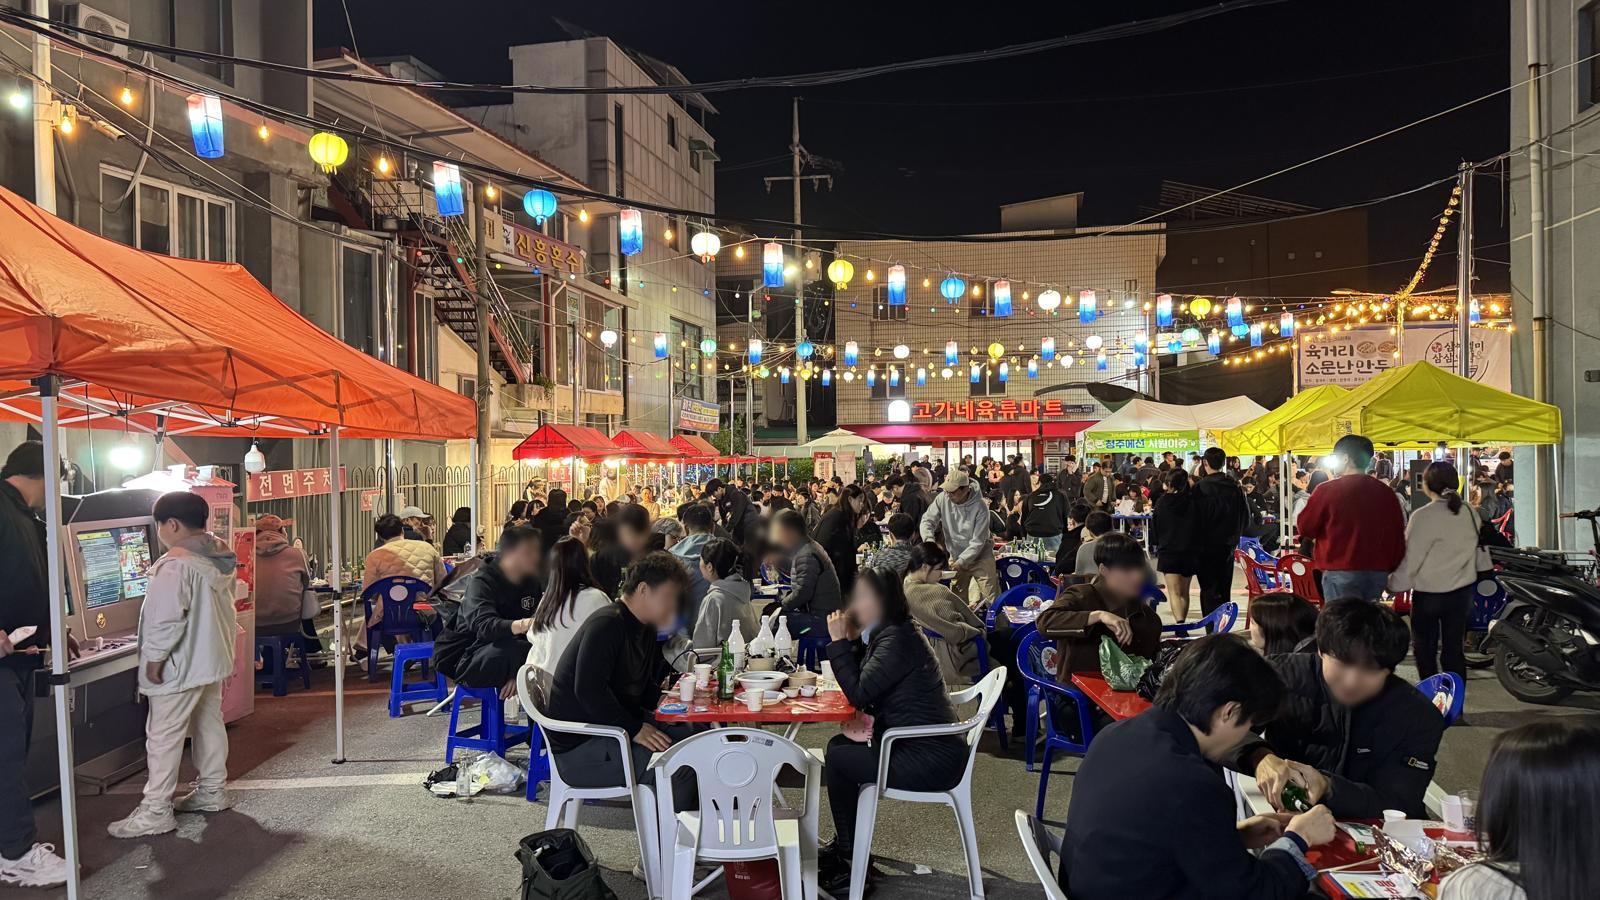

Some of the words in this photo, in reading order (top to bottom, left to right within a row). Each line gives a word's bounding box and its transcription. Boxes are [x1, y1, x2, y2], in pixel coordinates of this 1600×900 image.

[516, 232, 580, 273] 신흥혼수
[1305, 344, 1355, 359] 육거리
[912, 399, 1064, 421] 고가네육류마트
